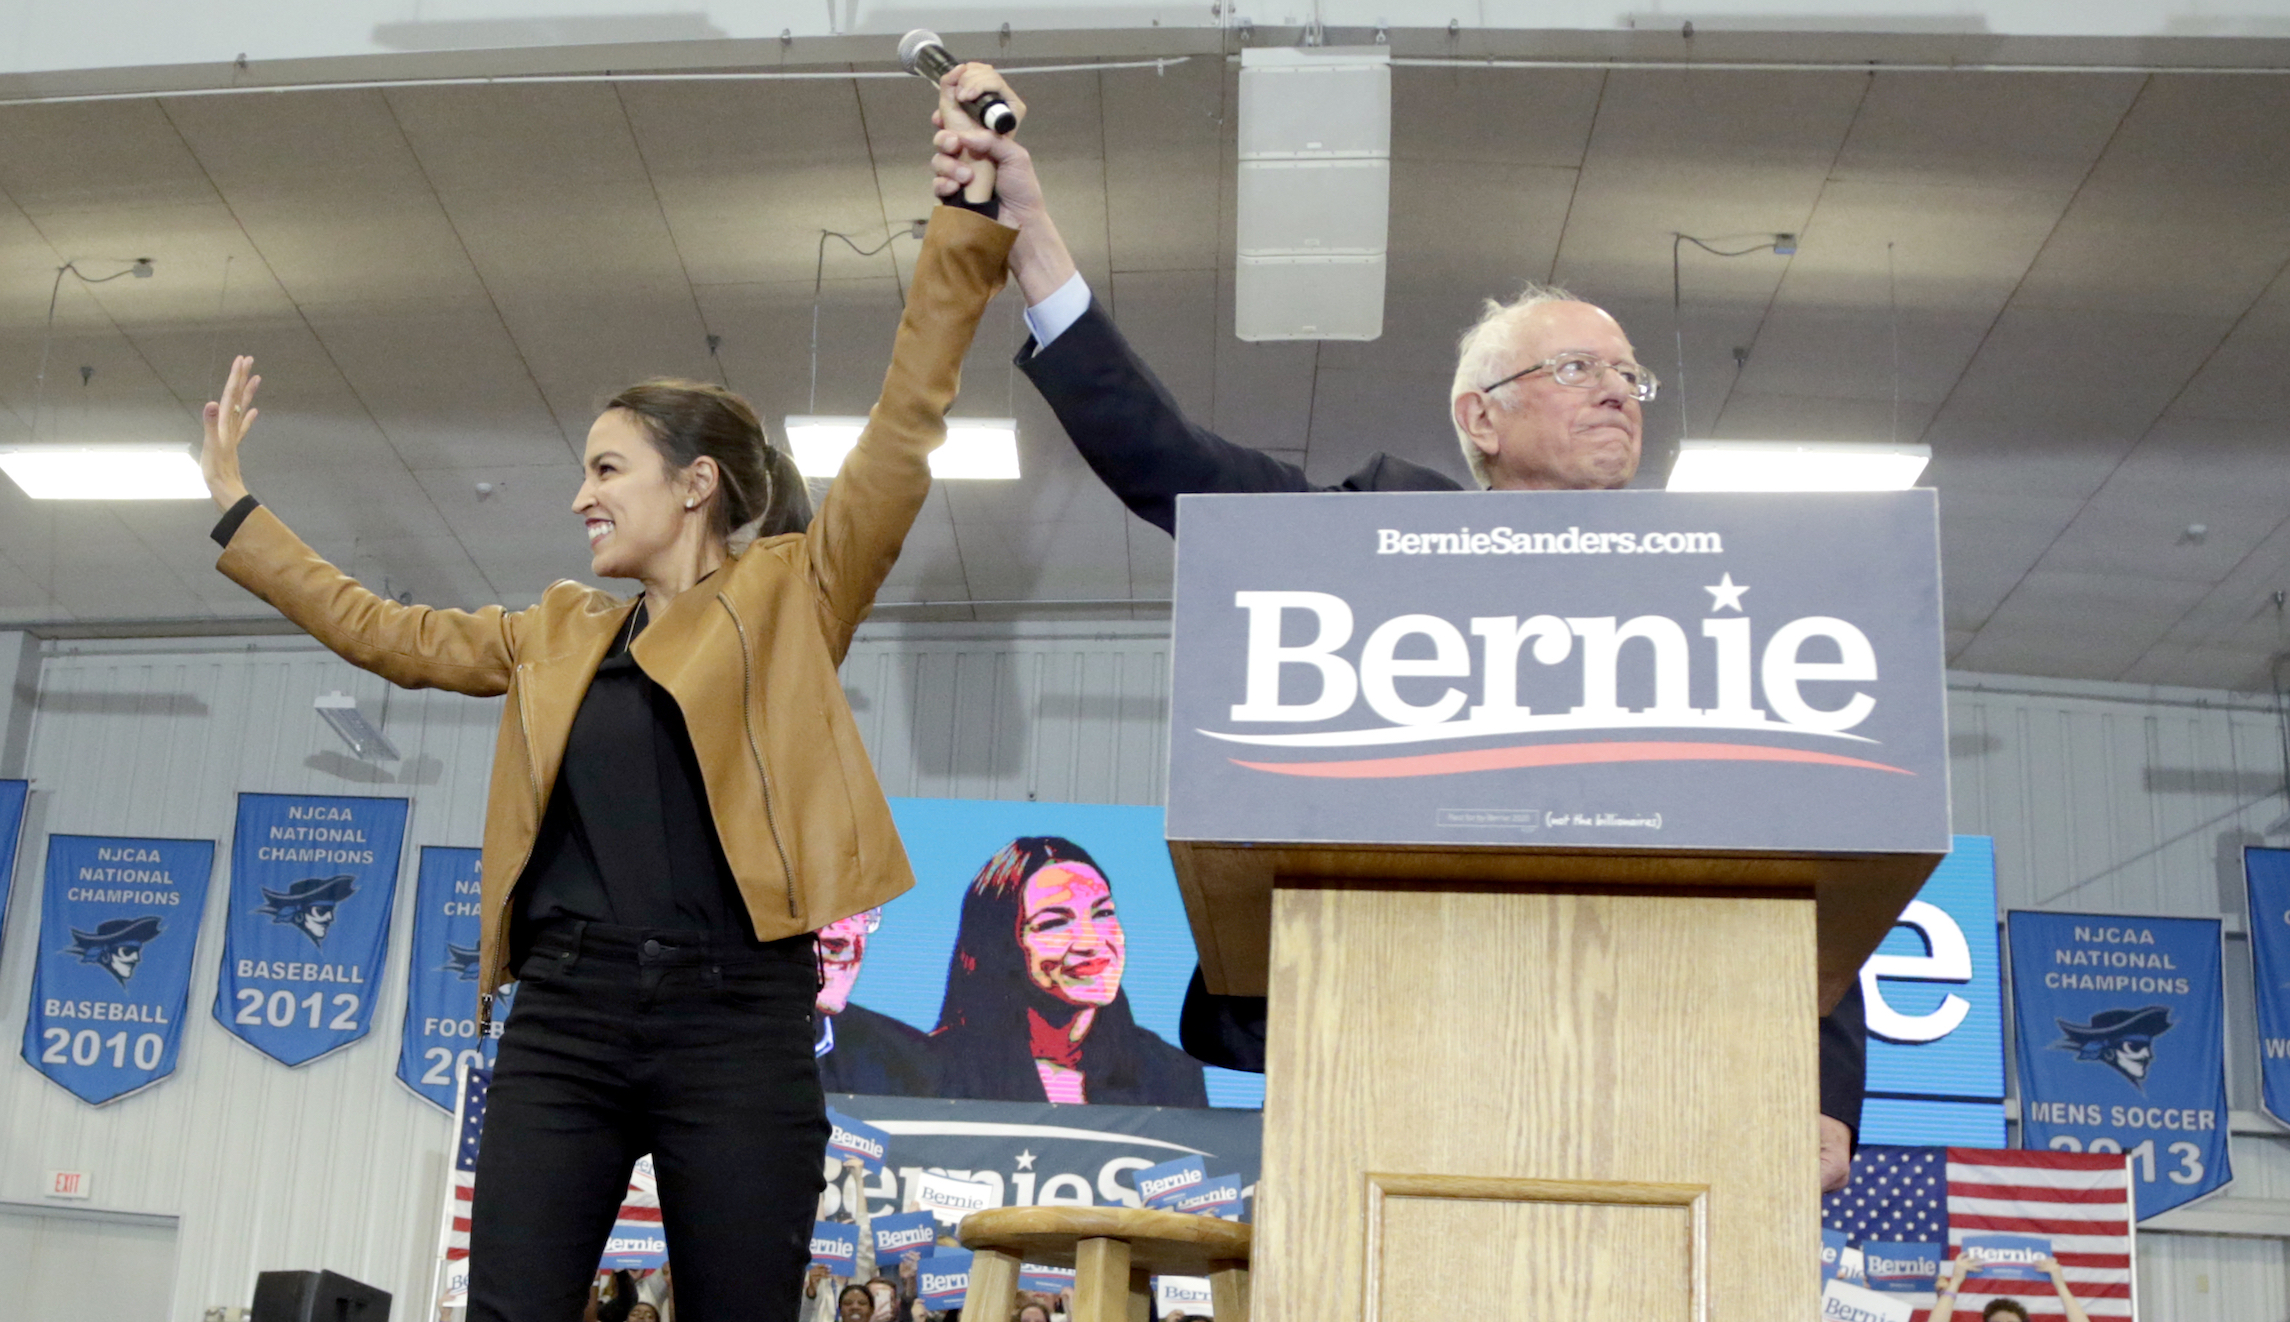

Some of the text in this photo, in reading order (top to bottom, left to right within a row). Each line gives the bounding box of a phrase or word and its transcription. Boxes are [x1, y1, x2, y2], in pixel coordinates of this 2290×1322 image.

[1377, 527, 1723, 556] BernieSanders.com
[1228, 572, 1880, 733] Bernie
[288, 806, 353, 823] NJCAA
[270, 826, 367, 844] NATIONAL
[98, 847, 162, 864] NJCAA
[258, 846, 374, 865] CHAMPIONS
[79, 867, 174, 885] NATIONAL
[67, 887, 181, 907] CHAMPIONS
[2074, 926, 2155, 945] NJCAA
[2055, 949, 2177, 970] NATIONAL
[236, 959, 364, 985] BASEBALL
[2045, 972, 2190, 995] CHAMPIONS
[44, 998, 169, 1025] BASEBALL
[235, 987, 360, 1031] 2012
[41, 1026, 164, 1072] 2010
[2031, 1101, 2216, 1131] MENS SOCCER
[831, 1125, 884, 1159] Bernie
[54, 1173, 80, 1193] EXIT
[1140, 1168, 1203, 1197] Bernie
[920, 1186, 984, 1209] Bernie
[876, 1224, 934, 1249] Bernie
[1867, 1255, 1936, 1276] Bernie
[920, 1269, 971, 1294] Bern
